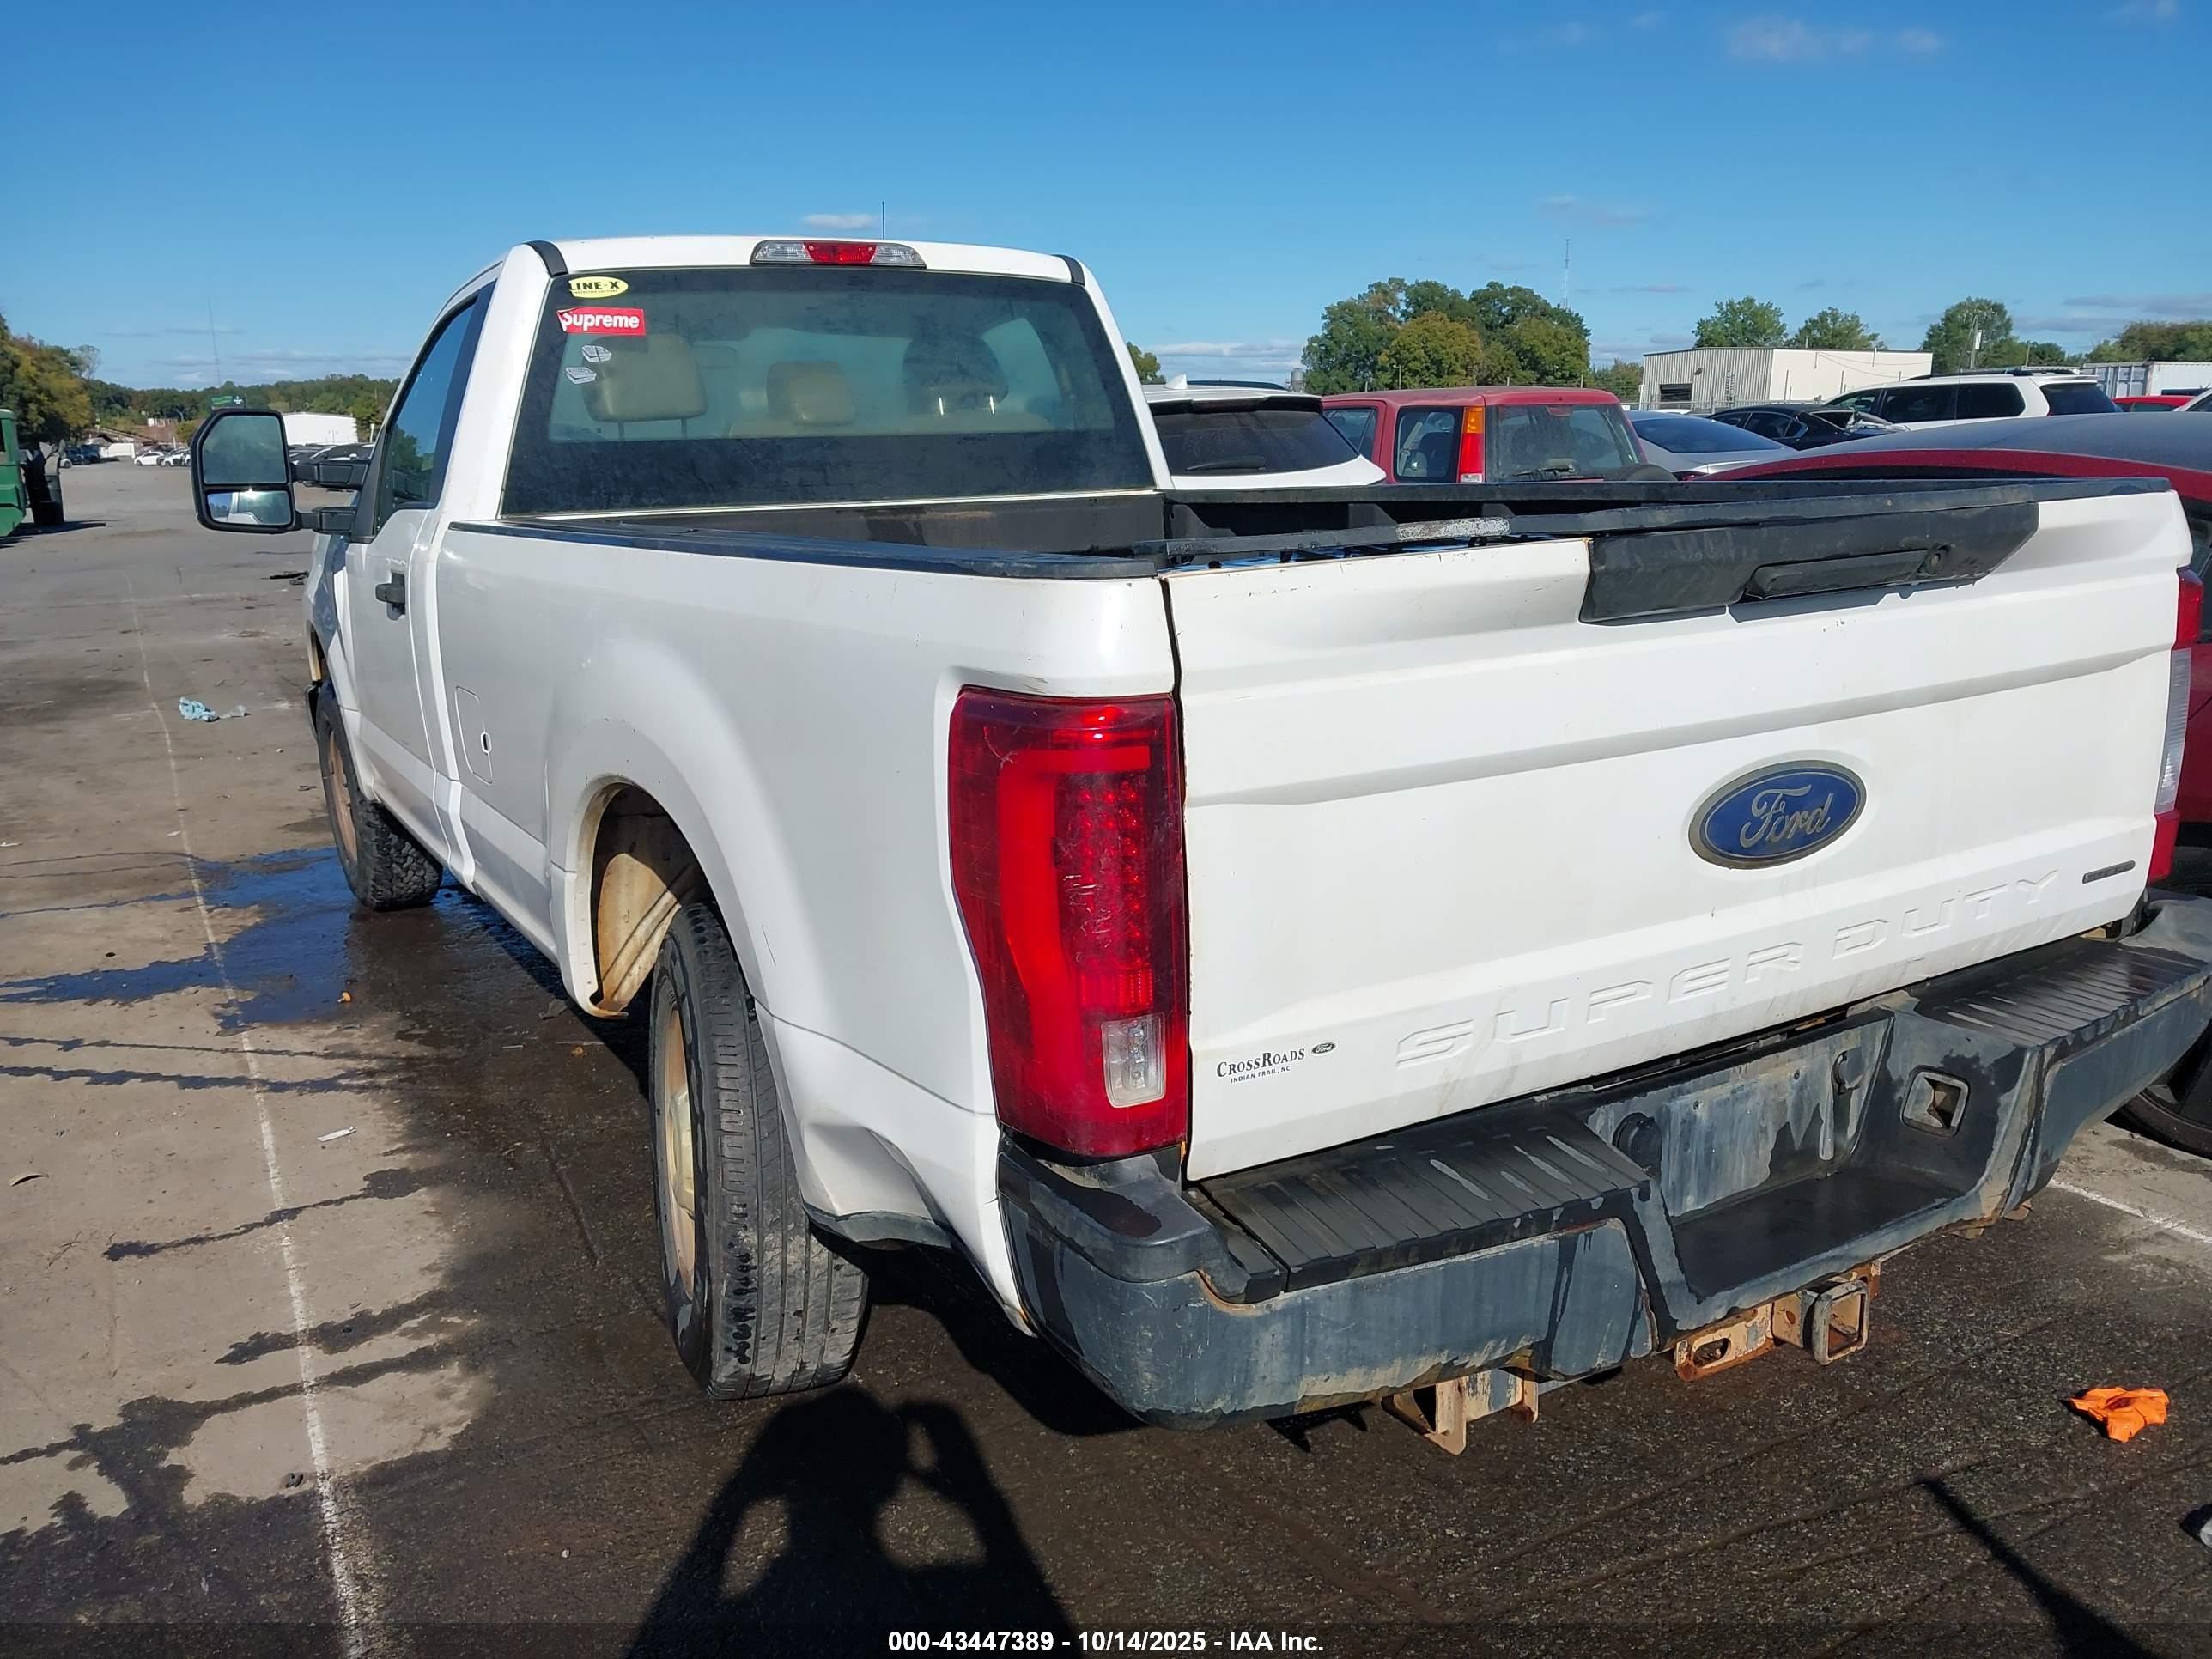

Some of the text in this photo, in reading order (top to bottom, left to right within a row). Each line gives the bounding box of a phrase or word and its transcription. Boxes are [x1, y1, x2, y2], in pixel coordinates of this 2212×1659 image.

[562, 313, 640, 331] Supreme
[1740, 784, 1834, 848] Ford
[1395, 870, 2058, 1070] SUPER DUTY
[1231, 1073, 1255, 1084] INDIAN
[1257, 1068, 1279, 1078] TRAIL,
